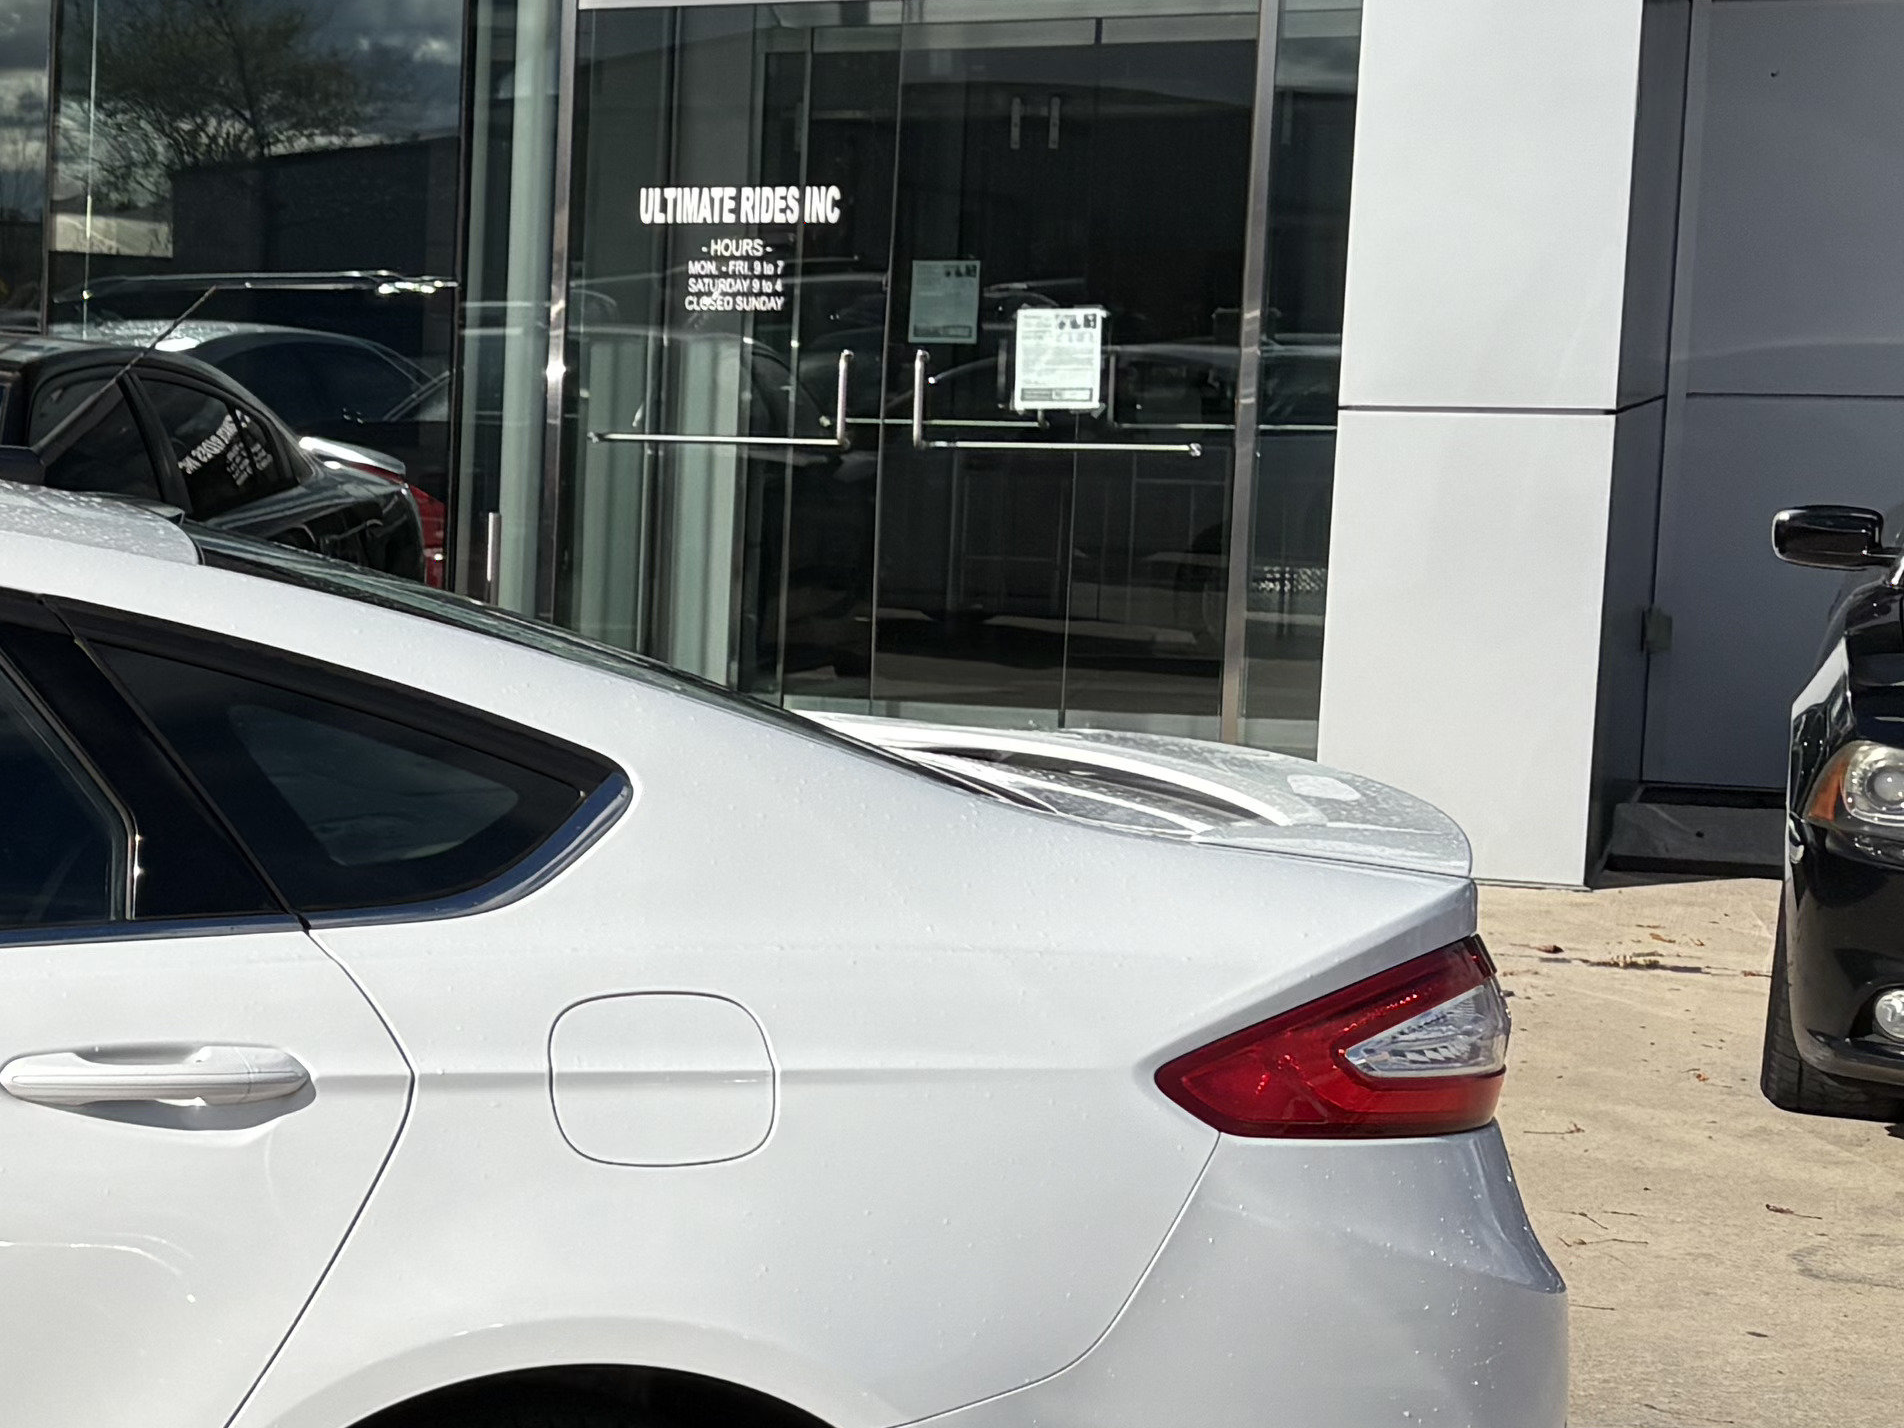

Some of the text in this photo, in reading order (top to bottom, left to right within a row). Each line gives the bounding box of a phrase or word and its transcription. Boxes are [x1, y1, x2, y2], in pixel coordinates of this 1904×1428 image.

[639, 185, 842, 225] ULTIMATE RIDES INC
[710, 238, 764, 257] HOURS
[687, 260, 719, 275] MON.
[763, 261, 775, 275] to
[687, 277, 751, 293] SATURDAY
[762, 279, 773, 293] to
[684, 295, 786, 311] CLOSED SUNDAY
